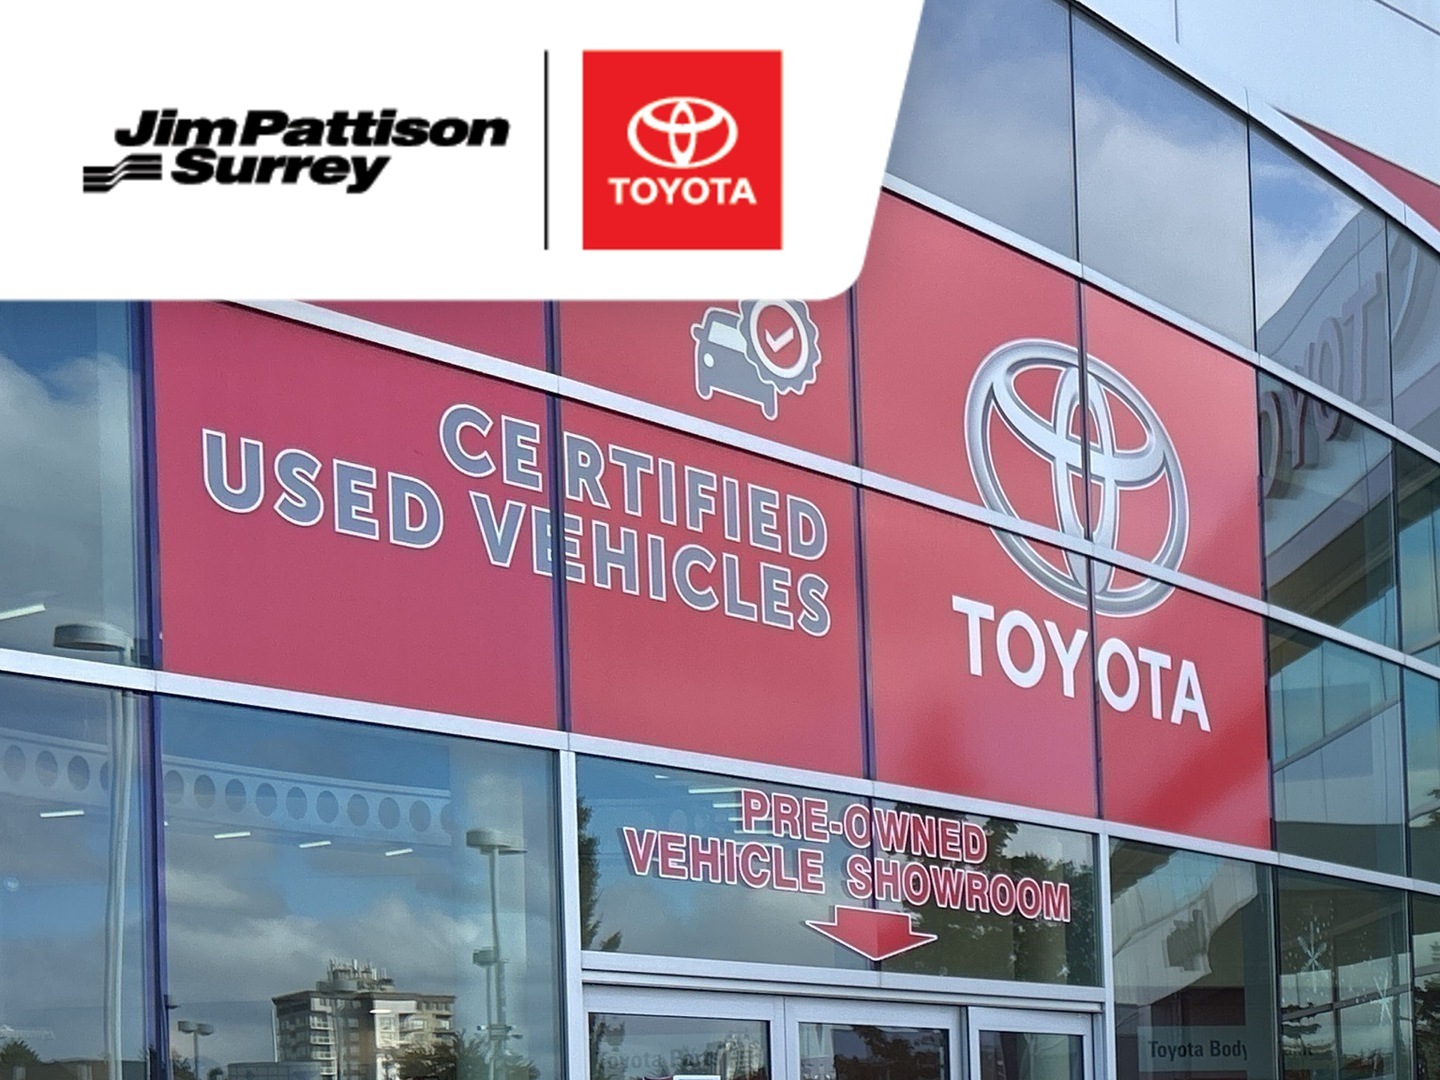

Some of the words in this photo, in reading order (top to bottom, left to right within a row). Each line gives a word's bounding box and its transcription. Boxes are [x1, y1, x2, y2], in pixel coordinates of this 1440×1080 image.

[201, 427, 445, 551] USED
[471, 491, 832, 639] VEHICLES
[438, 401, 829, 562] CERTIFIED
[951, 594, 1212, 733] TOYOTA
[623, 826, 827, 896] VEHICLE
[845, 852, 1072, 923] SHOWROOM
[740, 788, 988, 865] PRE-OWNED
[1149, 1040, 1204, 1062] Toyota
